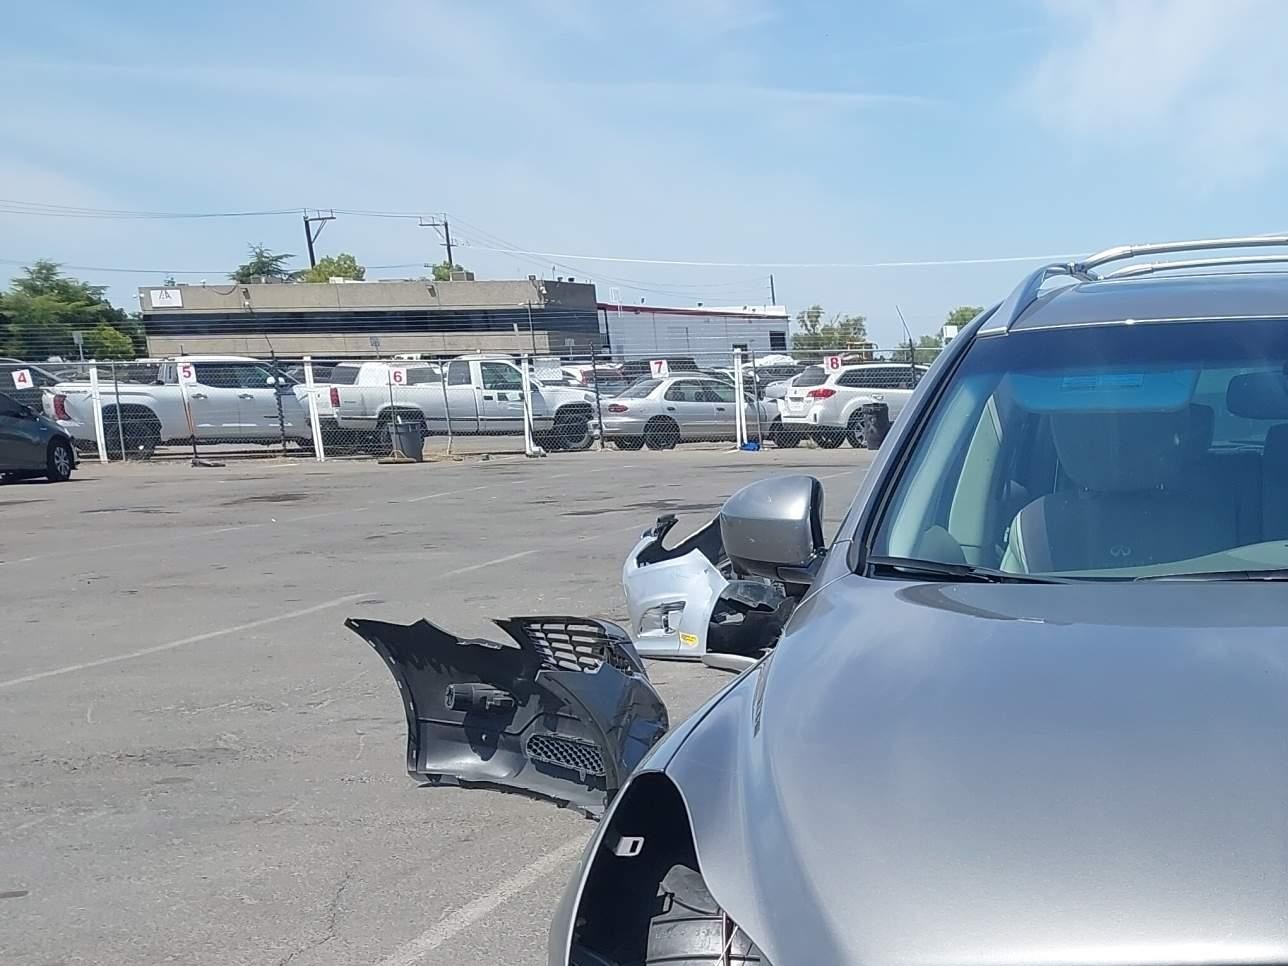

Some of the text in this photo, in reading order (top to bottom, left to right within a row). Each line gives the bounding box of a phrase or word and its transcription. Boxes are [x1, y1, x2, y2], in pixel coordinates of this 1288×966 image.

[654, 360, 663, 373] 7
[830, 357, 840, 369] 8
[17, 371, 28, 384] 4
[182, 365, 192, 379] 5
[393, 370, 403, 383] 6
